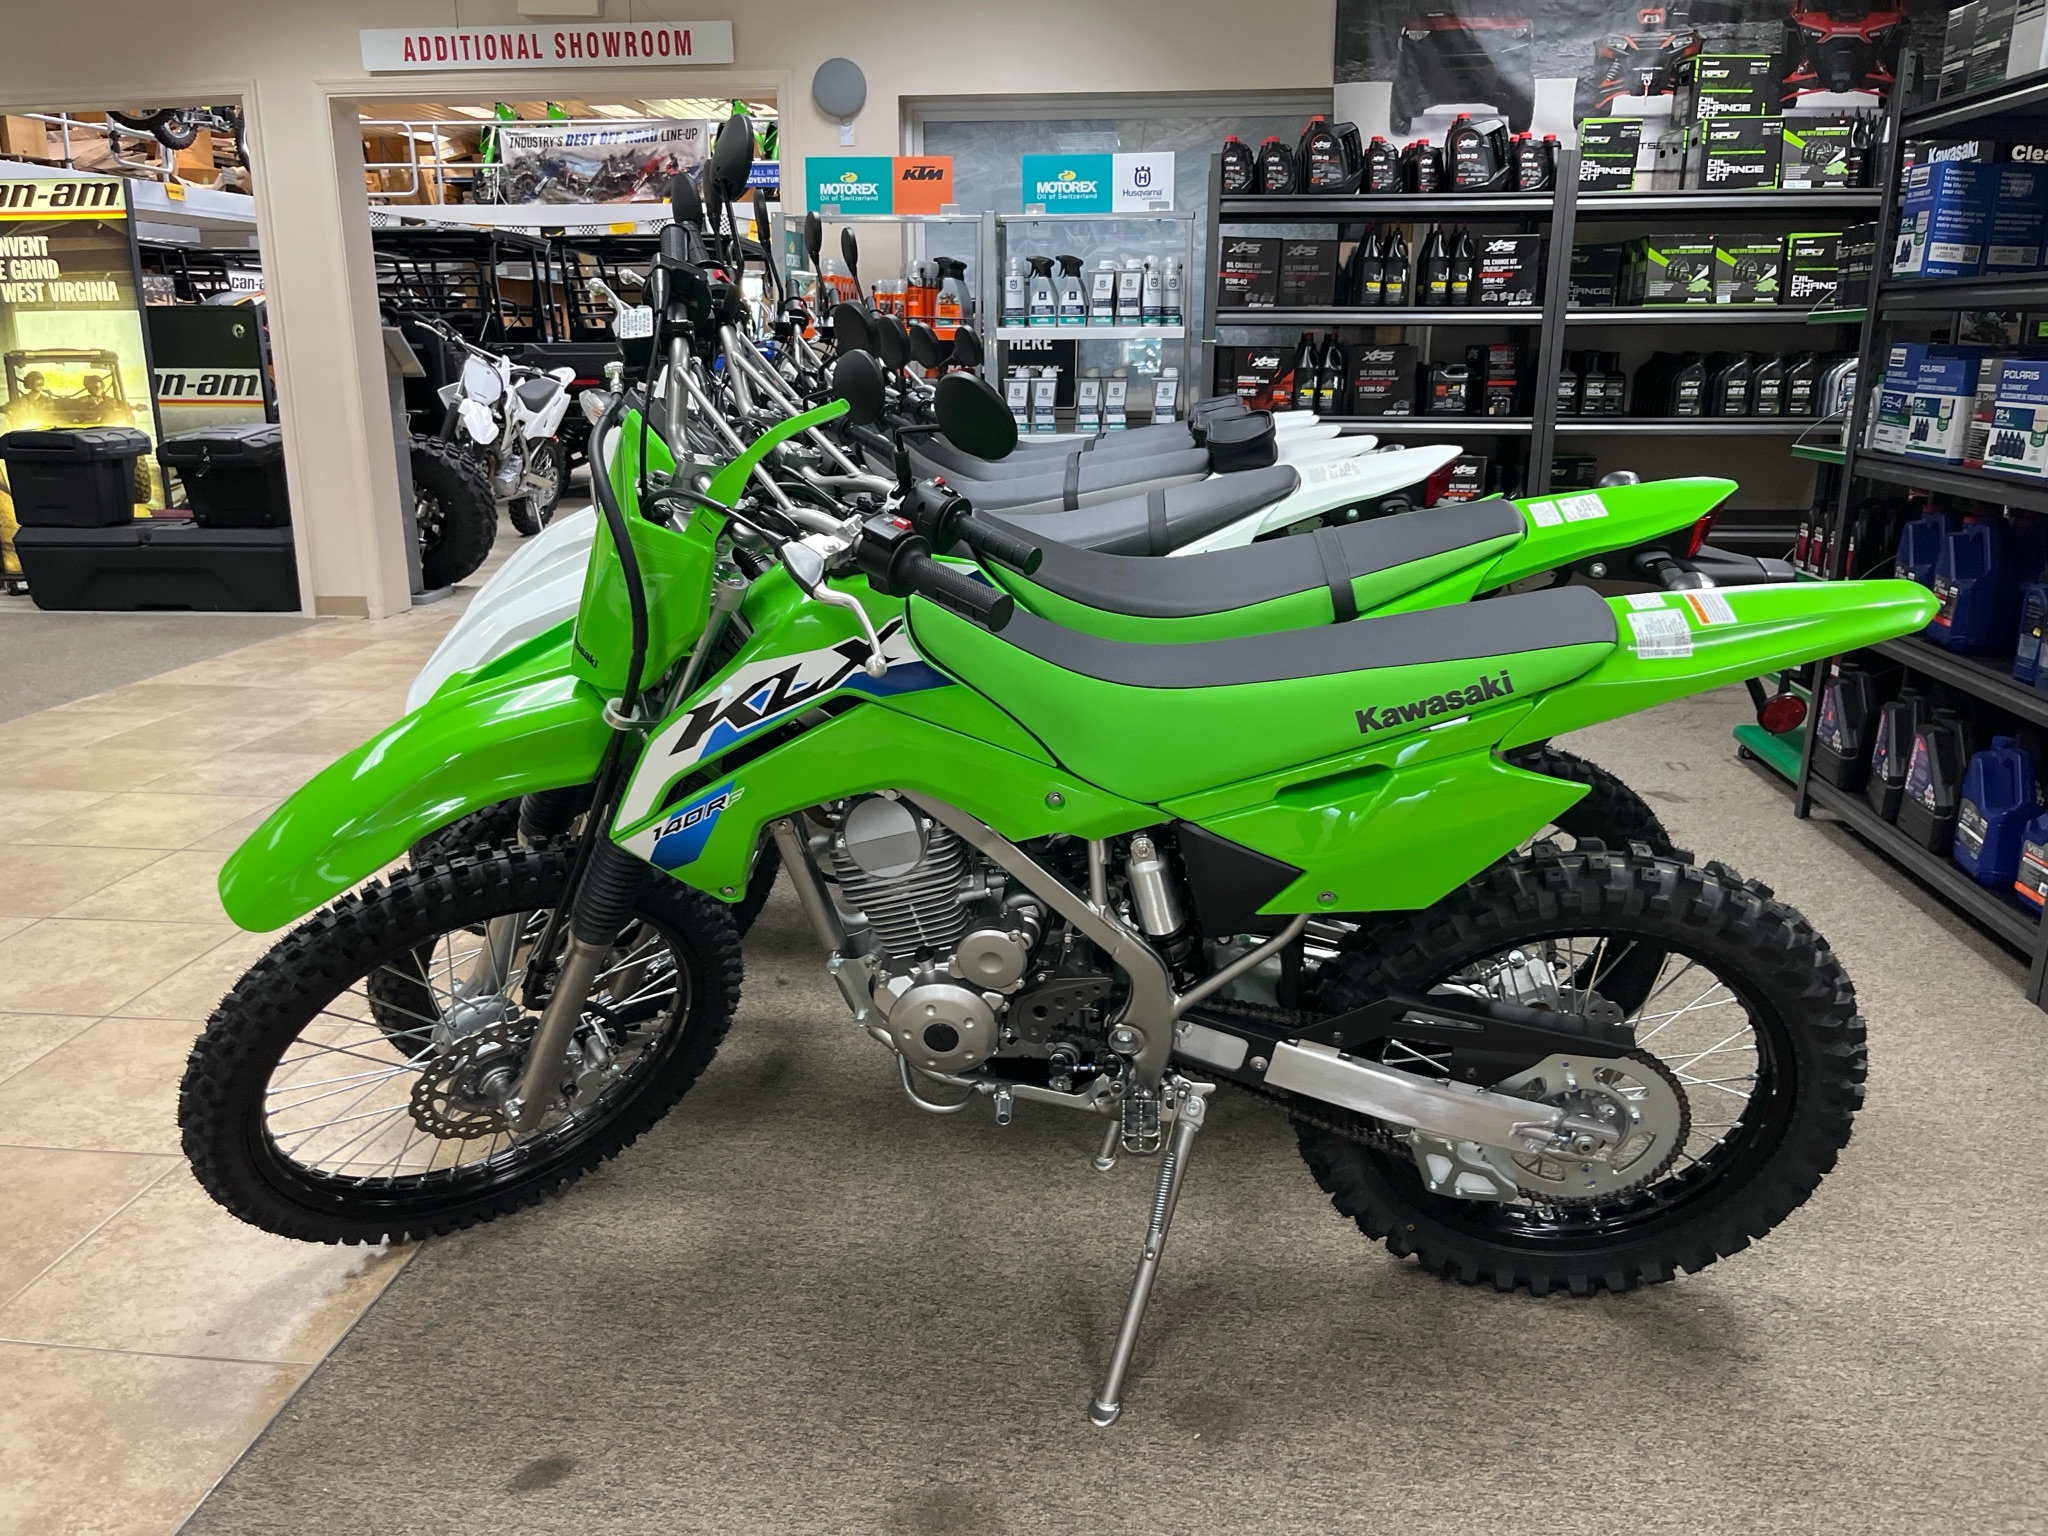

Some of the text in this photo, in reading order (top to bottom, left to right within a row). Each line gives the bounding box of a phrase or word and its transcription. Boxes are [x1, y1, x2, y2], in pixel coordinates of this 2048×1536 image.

[403, 29, 693, 62] ADDITIONAL SHOWROOM
[1699, 96, 1719, 104] OIL
[1698, 104, 1751, 112] CHANGE
[509, 136, 563, 149] INDUSTRY'S
[565, 133, 597, 147] BEST
[661, 128, 697, 142] LINE-UP
[1458, 138, 1478, 148] XPS
[1928, 141, 1979, 163] Kawasaki
[902, 165, 943, 180] KTM
[1707, 165, 1764, 173] CHANGE
[1706, 173, 1729, 181] KIT
[820, 183, 877, 195] MOTOREX
[1037, 181, 1097, 193] MOTOREX
[1058, 192, 1097, 200] Switzerland
[1122, 189, 1162, 199] Husqvarna
[1228, 241, 1262, 254] XPS
[1286, 244, 1319, 256] XPS
[1485, 240, 1518, 252] XPS
[10, 258, 60, 280] GRIND
[1792, 282, 1837, 290] CHANG
[1, 281, 120, 303] WEST VIRGINIA
[1010, 339, 1053, 350] HERE
[1252, 356, 1280, 366] XPS
[1362, 350, 1395, 361] XPS
[1919, 364, 1946, 373] POLARIS
[2003, 370, 2040, 380] POLARIS
[156, 374, 259, 396] n-am
[1881, 395, 1901, 409] PS-4
[1996, 408, 2010, 419] PS-4
[1453, 464, 1478, 475] XPS
[669, 616, 904, 757] KLX
[1355, 669, 1515, 734] Kawasaki
